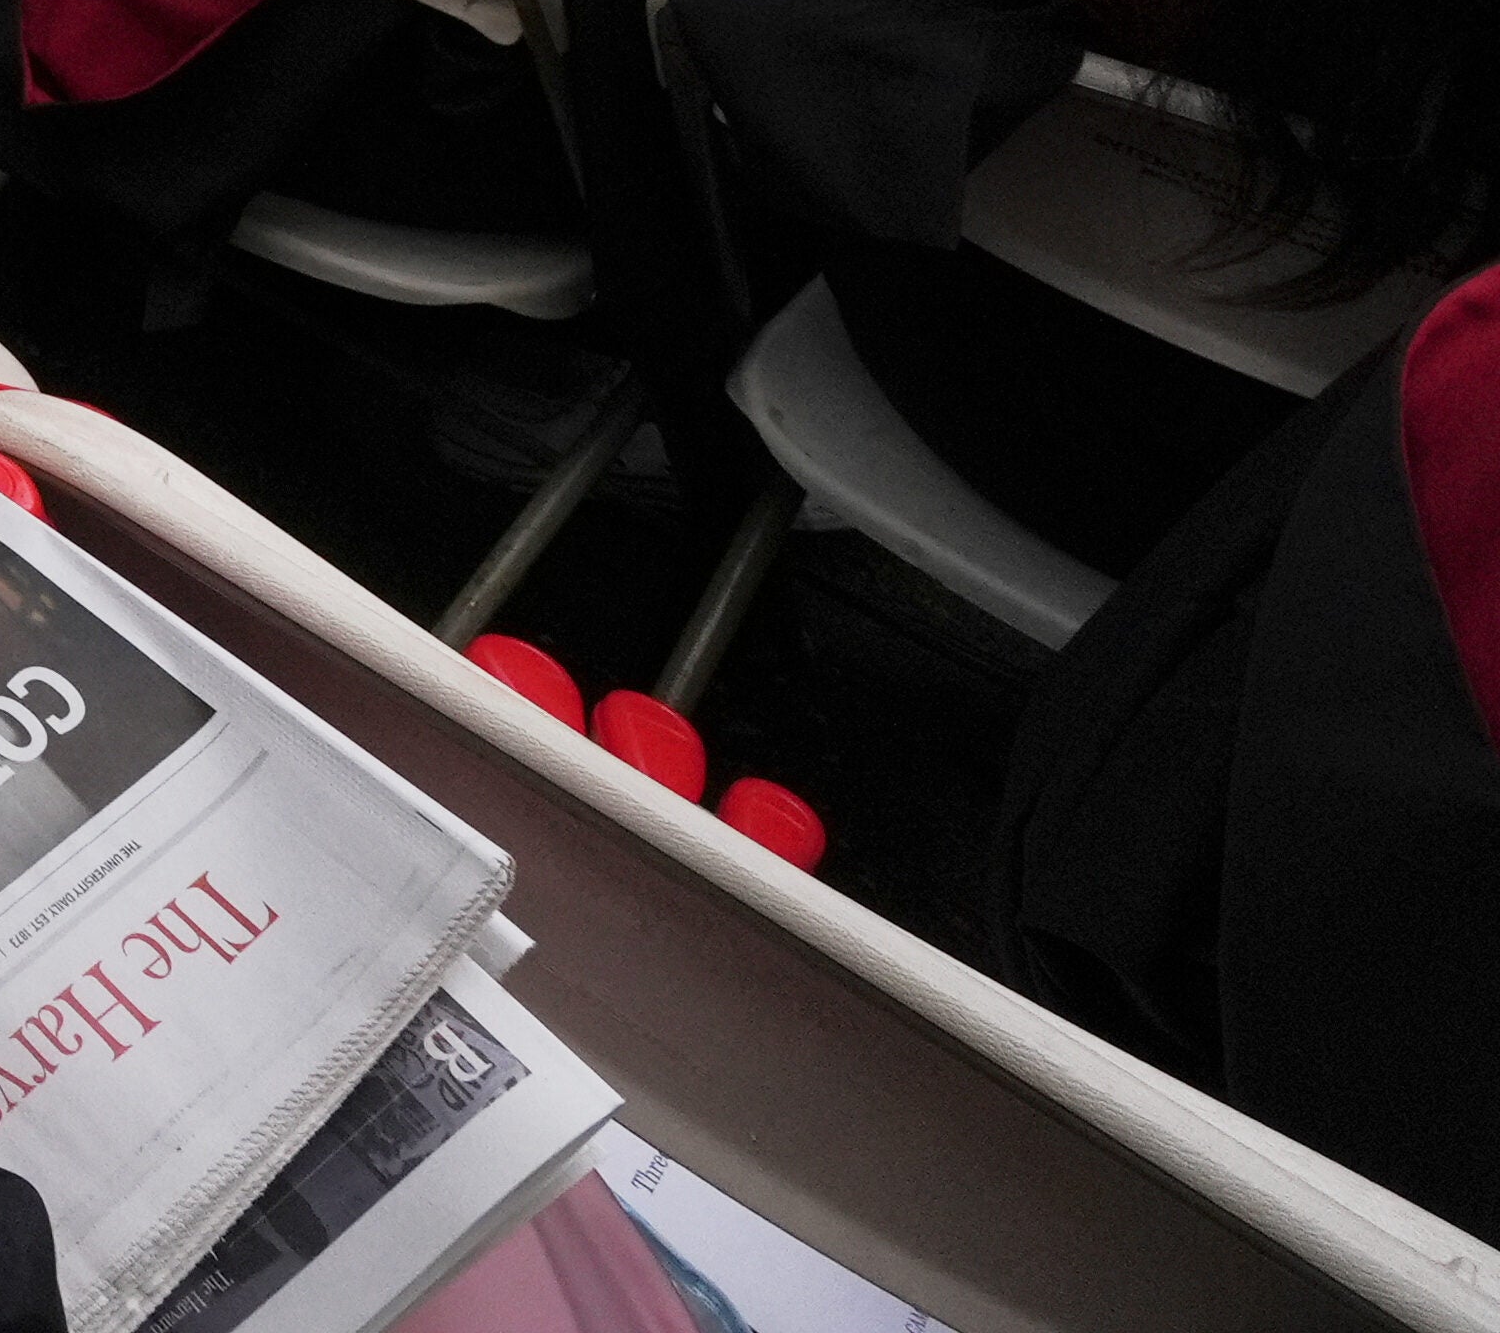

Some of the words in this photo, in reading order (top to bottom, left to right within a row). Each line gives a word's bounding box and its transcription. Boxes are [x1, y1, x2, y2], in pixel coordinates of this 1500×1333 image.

[120, 839, 143, 861] THE
[72, 856, 123, 899] UNIVERSITY
[50, 887, 78, 919] DAILY,
[8, 926, 33, 950] 1873
[118, 870, 281, 981] The
[423, 1020, 494, 1083] B
[202, 1270, 235, 1295] The
